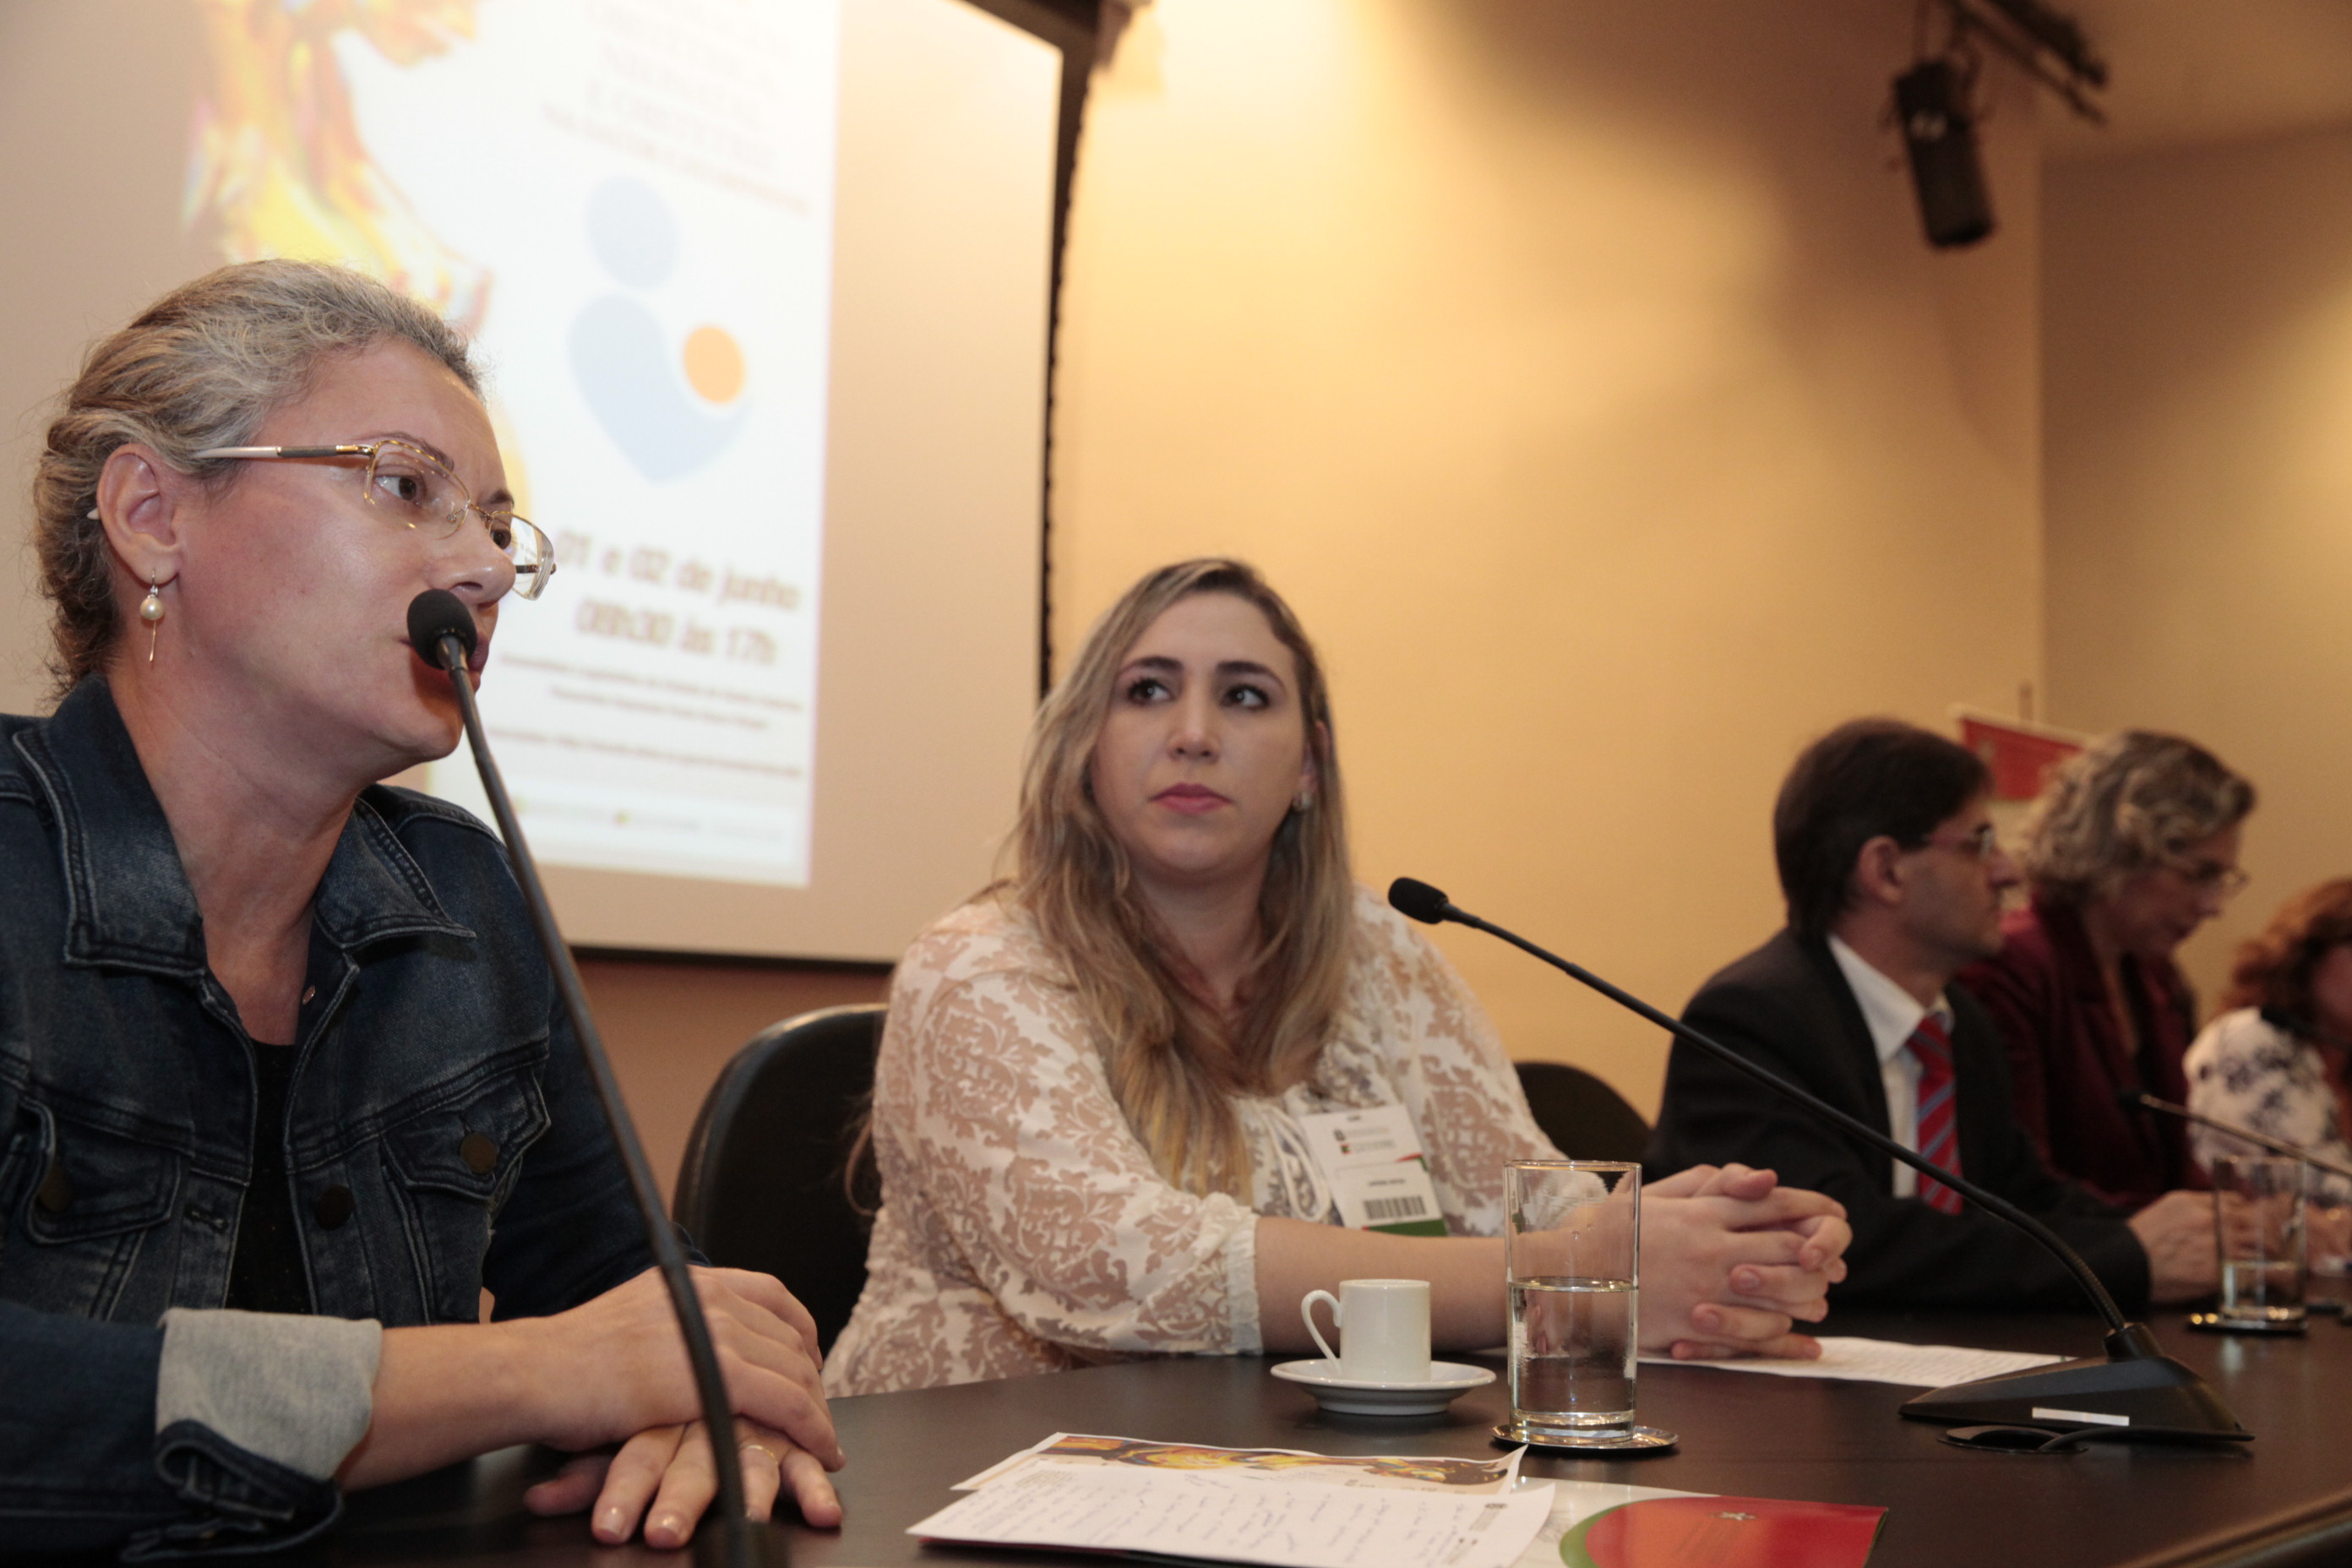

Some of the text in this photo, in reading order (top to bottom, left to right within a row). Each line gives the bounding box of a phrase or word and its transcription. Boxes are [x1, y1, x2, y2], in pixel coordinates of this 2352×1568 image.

[558, 531, 592, 568] 01
[602, 546, 623, 575] e
[631, 547, 671, 584] 02
[678, 561, 713, 594] de
[720, 565, 801, 610] junho
